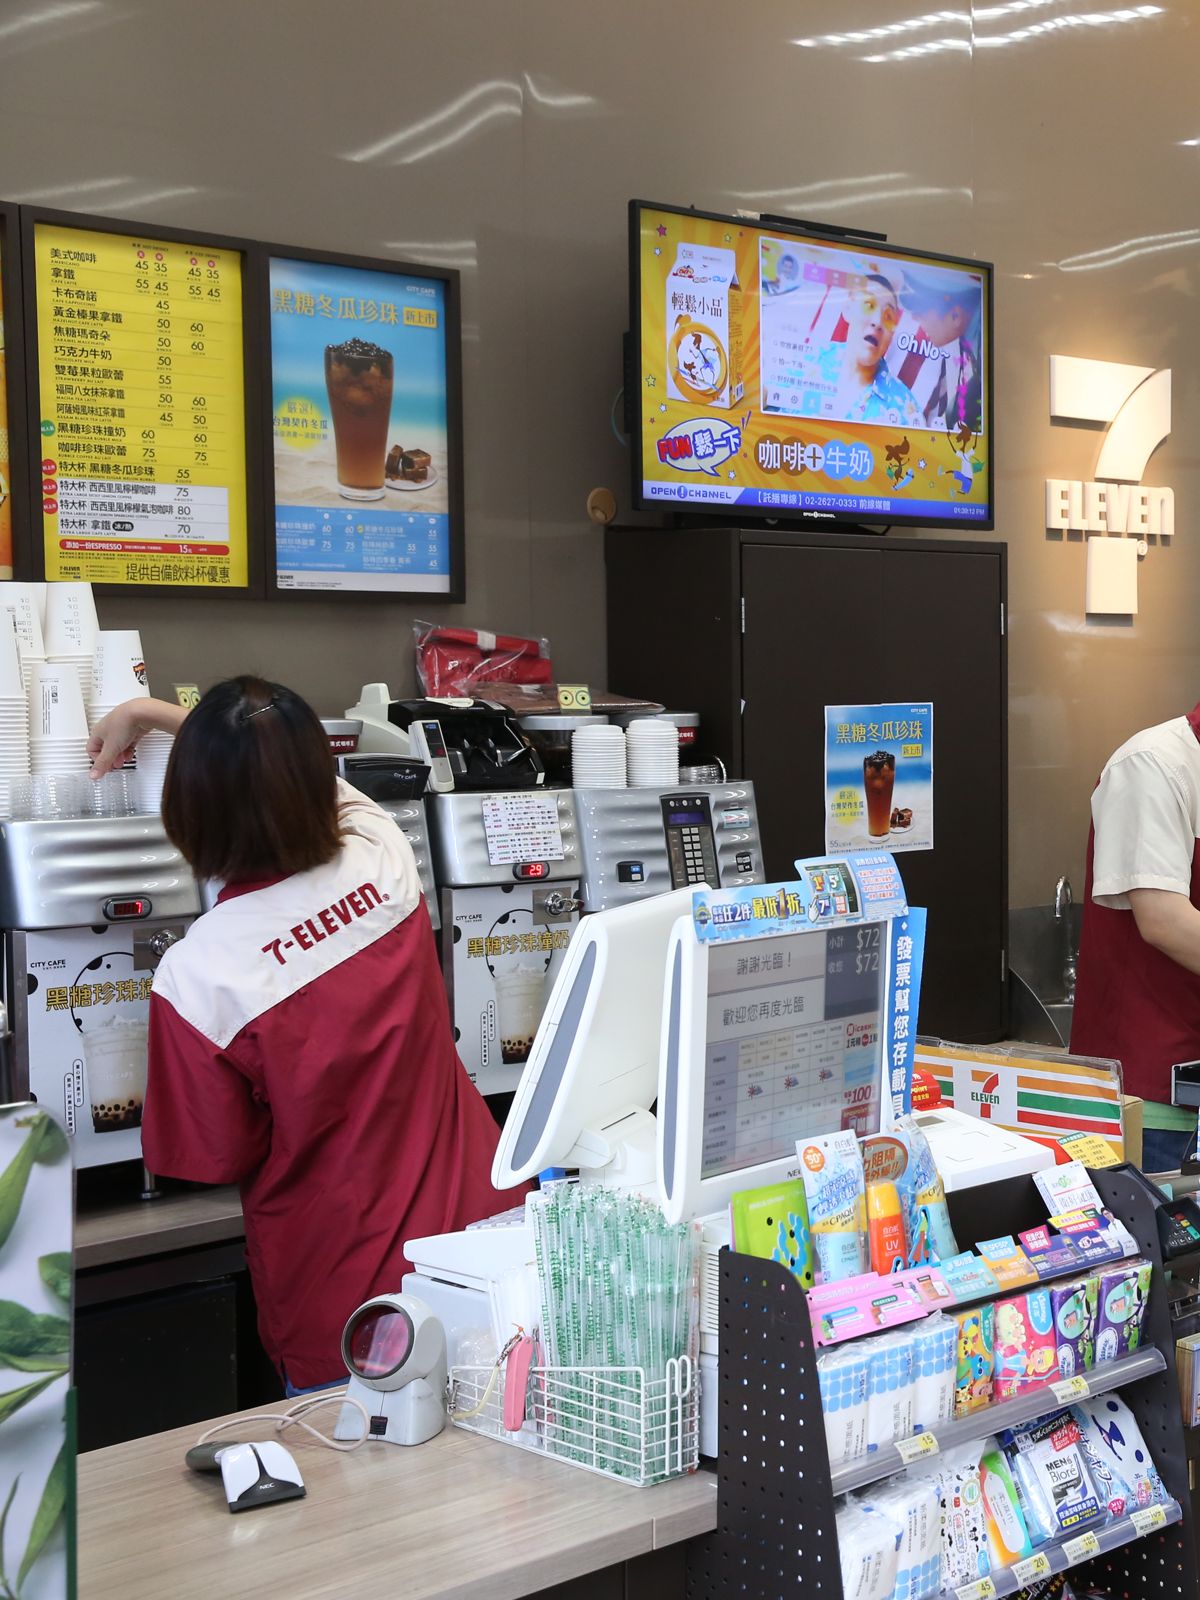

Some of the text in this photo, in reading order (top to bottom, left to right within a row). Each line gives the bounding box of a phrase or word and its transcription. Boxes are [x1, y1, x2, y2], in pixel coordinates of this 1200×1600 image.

[50, 248, 220, 280] 美式咖啡 45 35 45 35
[51, 267, 221, 298] 拿鐵 55 45 55 45
[52, 286, 170, 310] 卡布奇諾 45
[671, 291, 723, 318] 輕鬆小品
[272, 288, 400, 326] 黑糖冬瓜珍珠
[156, 319, 171, 329] 50
[190, 323, 204, 333] 60
[157, 338, 171, 348] 50
[191, 341, 204, 351] 60
[54, 345, 172, 366] 巧克力牛奶 50
[158, 375, 172, 385] 55
[159, 394, 173, 404] 50
[192, 396, 206, 407] 60
[160, 412, 173, 422] 45
[193, 415, 206, 425] 50
[57, 422, 207, 444] 黑糖珍珠撞奶 60 60
[142, 447, 155, 458] 75
[195, 451, 207, 461] 75
[59, 461, 190, 479] 特大杯 黑糖冬瓜珍珠 55
[59, 480, 87, 492] 特大杯
[176, 487, 189, 497] 75
[60, 499, 87, 511] 特大杯
[177, 506, 191, 516] 80
[805, 495, 857, 509] 02-2627-0333
[60, 518, 88, 530] 特大杯
[177, 524, 191, 534] 70
[126, 563, 231, 584] 提供自備飲料杯優惠
[835, 720, 923, 744] 黑糖冬瓜珍珠
[467, 929, 570, 959] 黑糖珍珠撞奶
[856, 929, 880, 949] $72
[30, 959, 66, 969] CITY CAFE
[855, 953, 879, 975] $72
[723, 996, 805, 1026] 歡迎您再度光臨
[886, 1239, 899, 1251] UV
[1070, 1377, 1083, 1389] 15
[921, 1435, 935, 1448] 15
[259, 1482, 275, 1490] NEC
[1033, 1557, 1045, 1569] 20
[980, 1582, 991, 1594] 45
